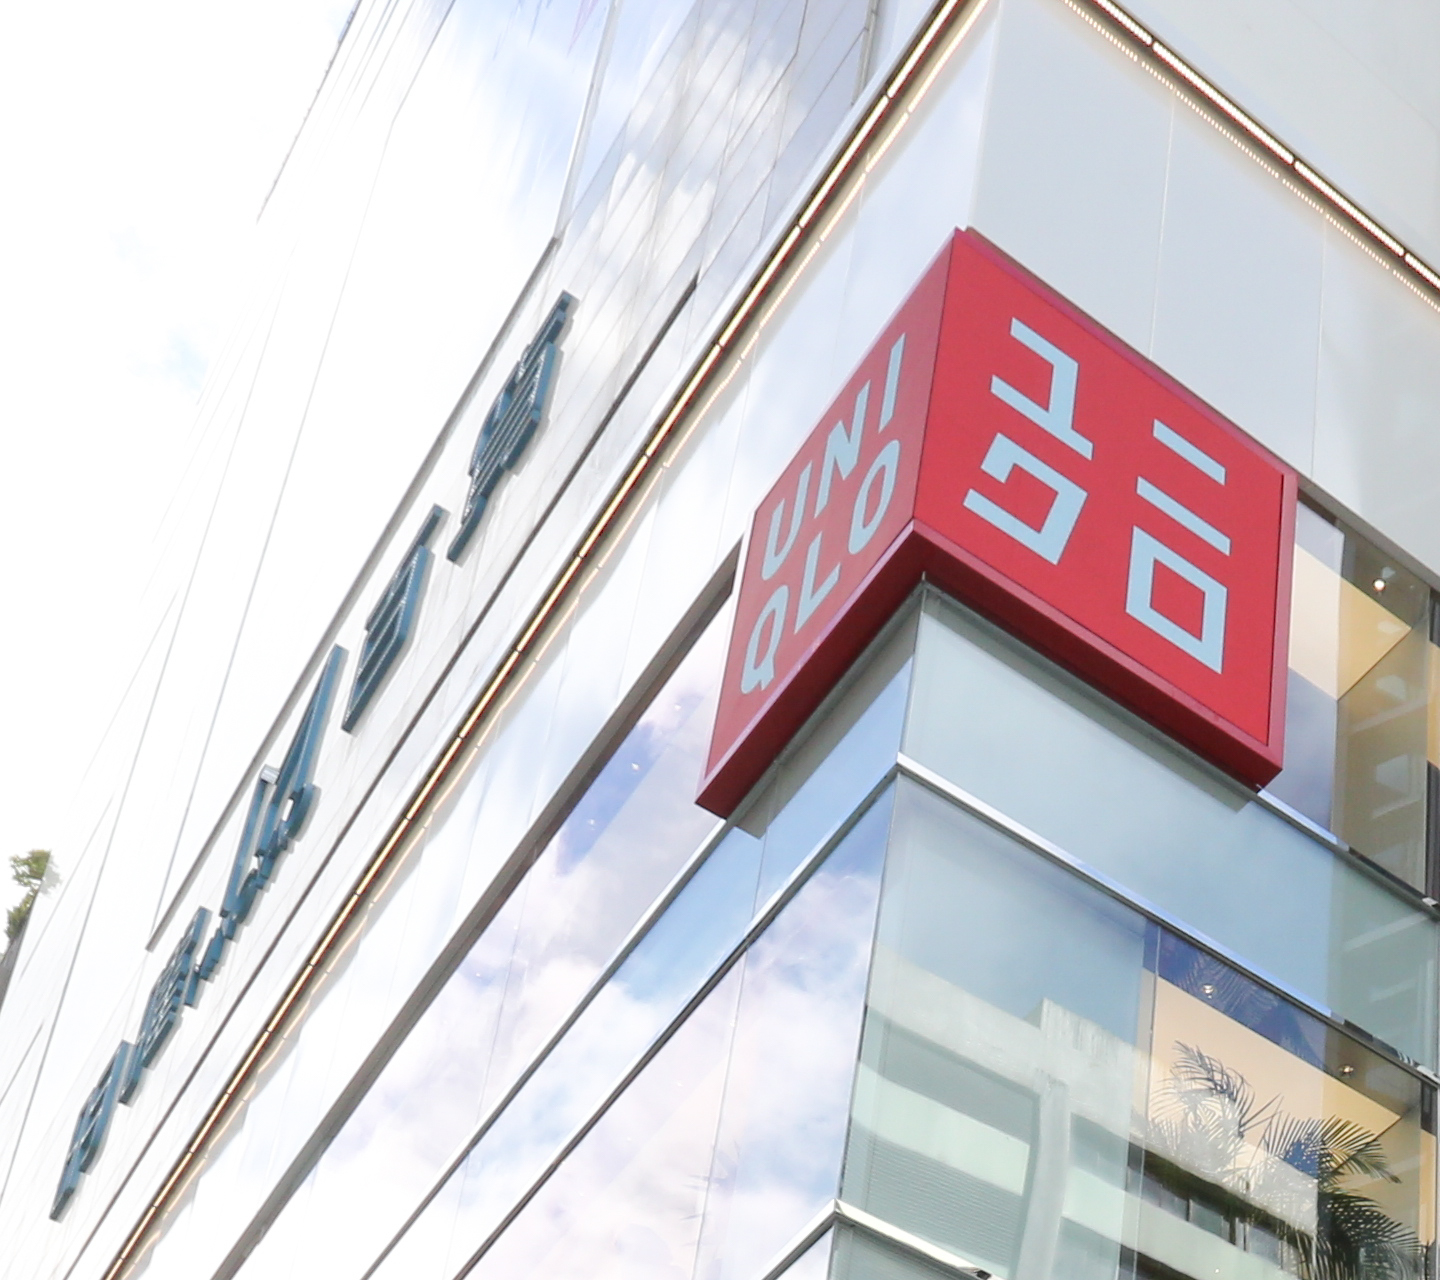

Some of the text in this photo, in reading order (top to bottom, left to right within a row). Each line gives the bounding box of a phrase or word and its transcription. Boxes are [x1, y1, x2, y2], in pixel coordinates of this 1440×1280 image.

[761, 331, 906, 580] UNI
[990, 316, 1227, 487] ユニ
[741, 439, 900, 696] QLO
[963, 431, 1228, 675] クロ
